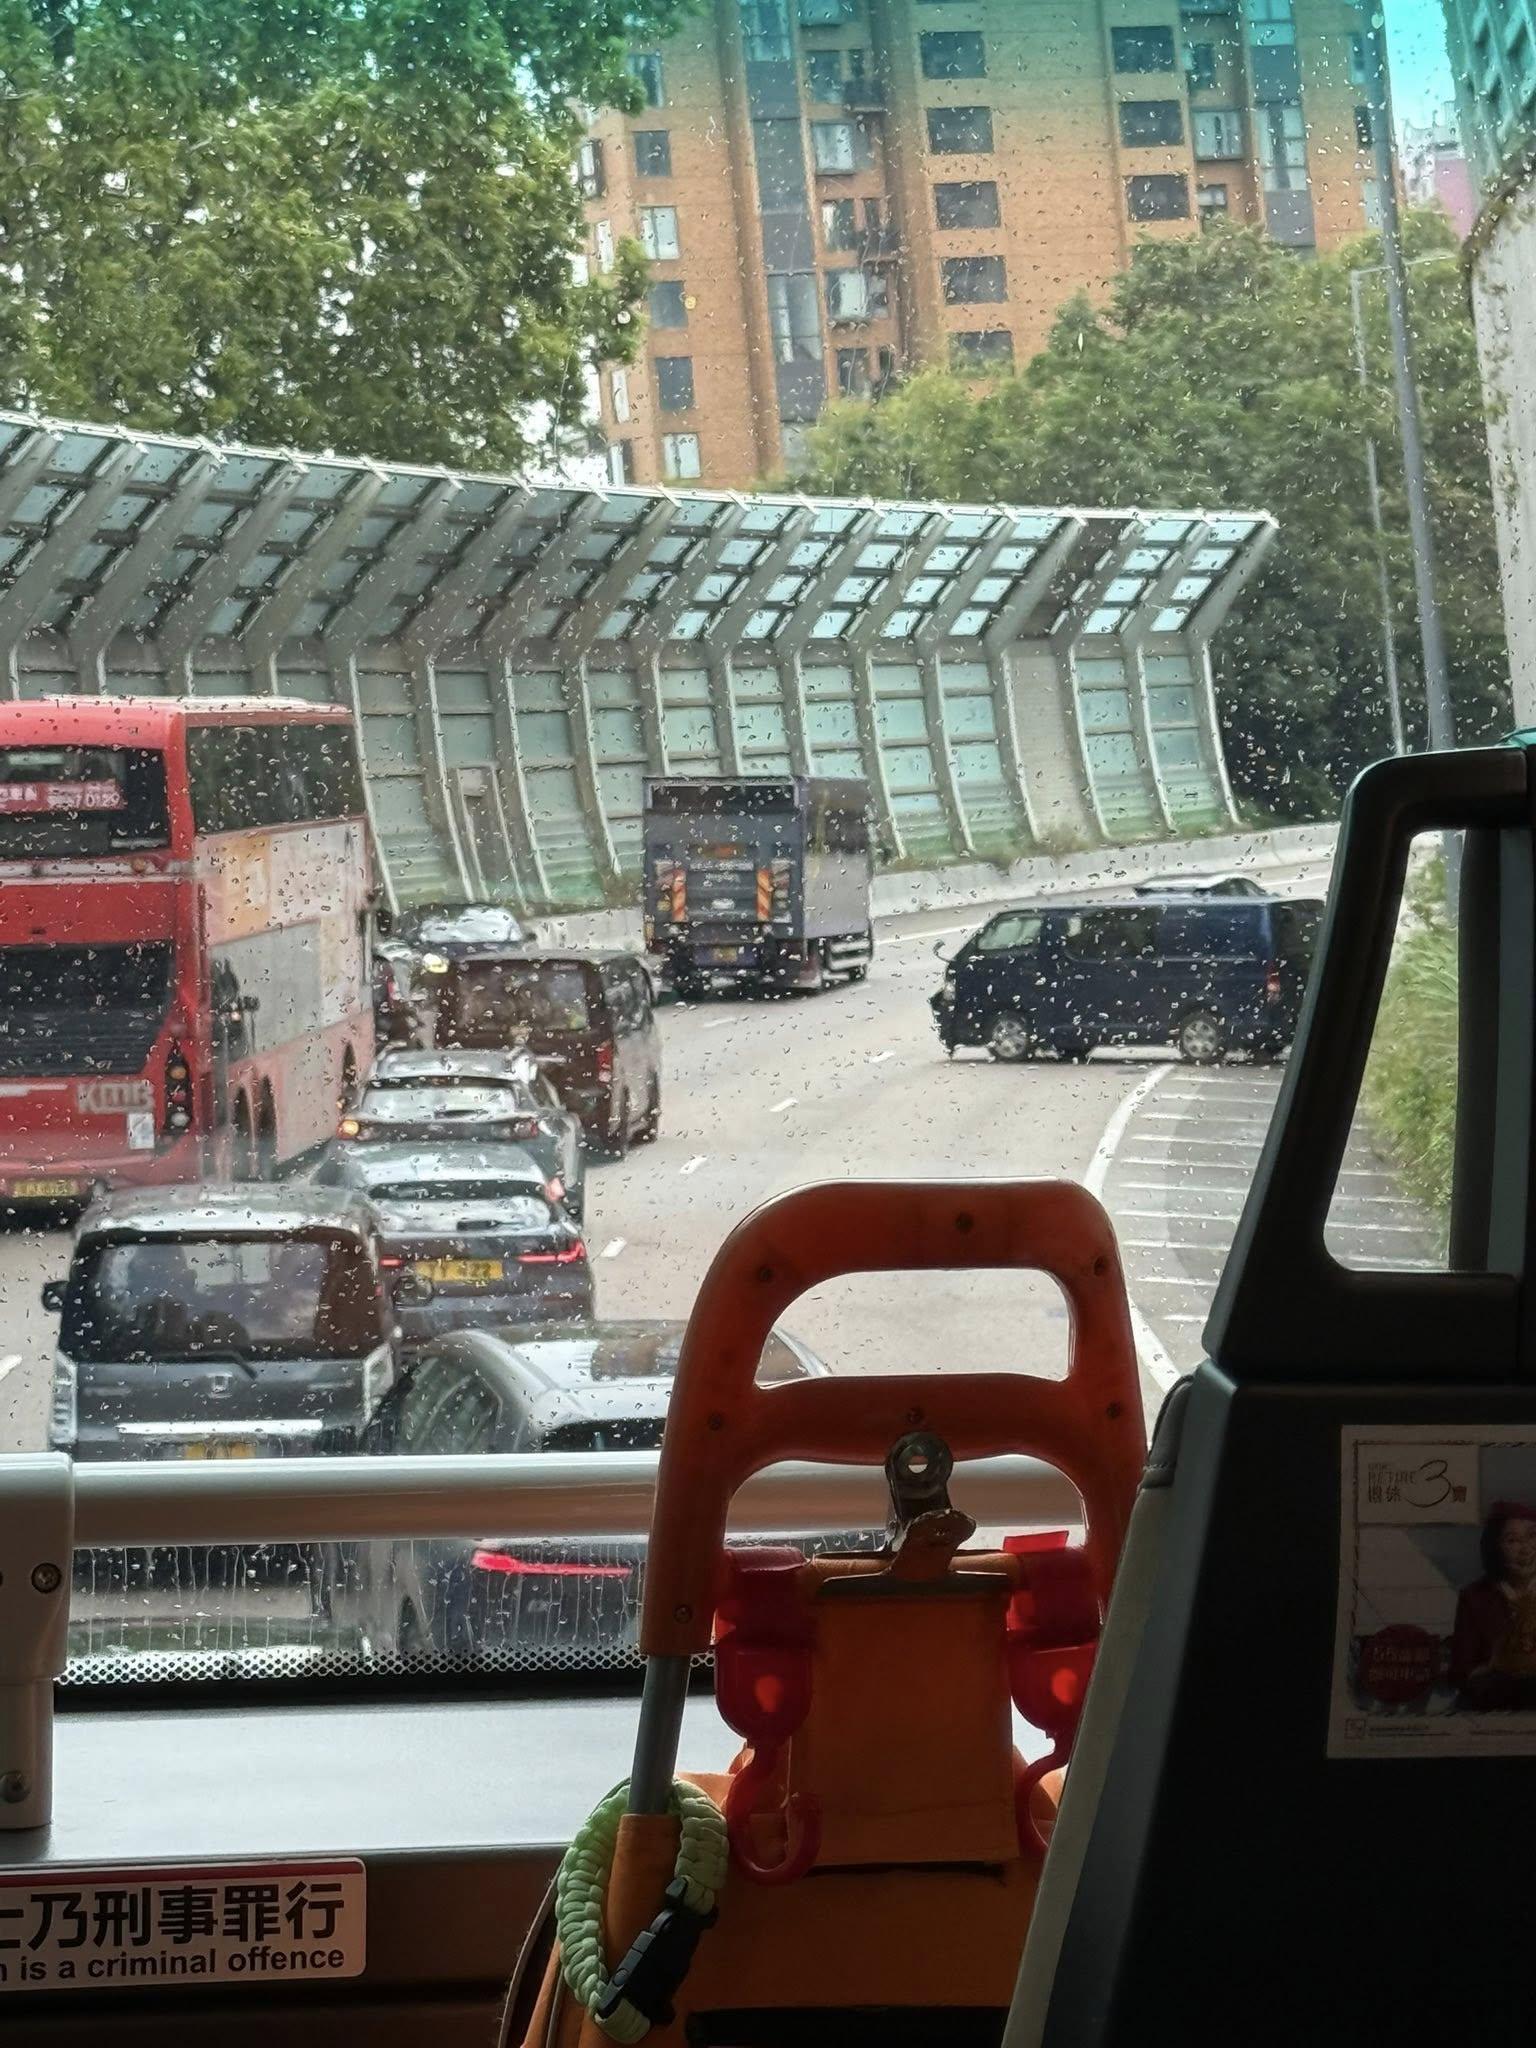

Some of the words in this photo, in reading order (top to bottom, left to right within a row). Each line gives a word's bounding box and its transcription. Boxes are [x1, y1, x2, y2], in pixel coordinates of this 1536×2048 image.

[20, 1956, 47, 1981] is
[58, 1960, 76, 1979] a
[88, 1949, 216, 1978] criminal
[228, 1946, 344, 1972] offence
